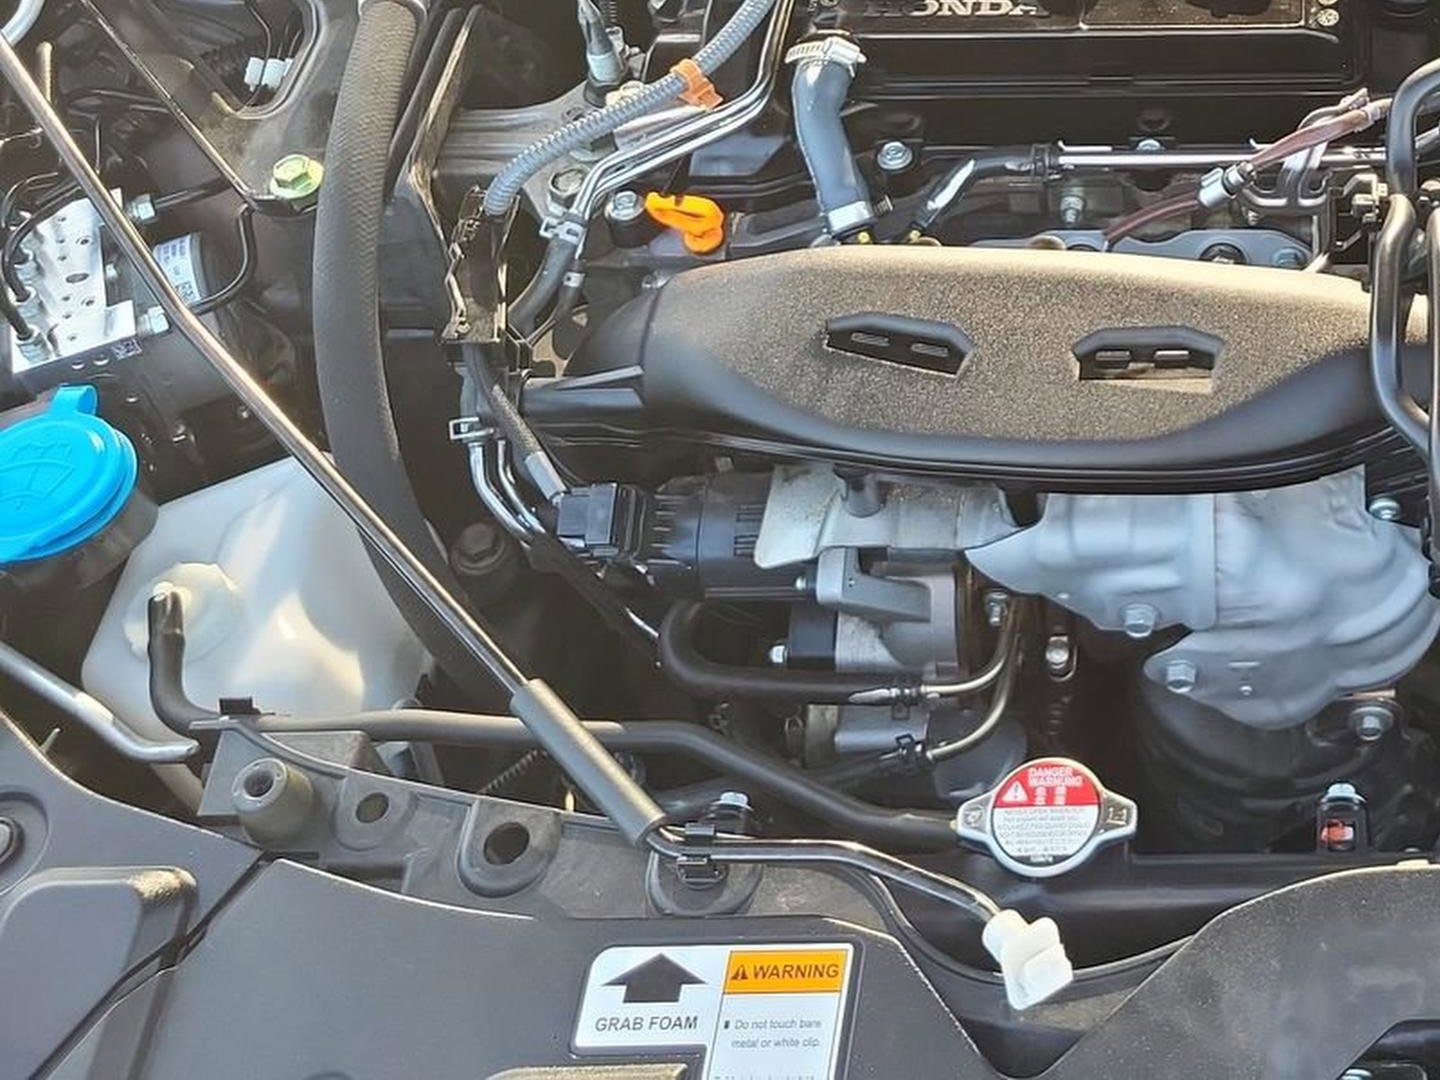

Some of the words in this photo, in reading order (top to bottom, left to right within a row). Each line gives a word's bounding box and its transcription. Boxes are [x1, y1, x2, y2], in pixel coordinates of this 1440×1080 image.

[1029, 767, 1072, 777] DANGER
[753, 963, 839, 979] WARNING
[594, 1016, 644, 1032] GRAB
[648, 1016, 698, 1031] FOAM
[735, 1019, 749, 1030] Do
[752, 1019, 768, 1029] not
[769, 1019, 798, 1029] touch
[731, 1037, 759, 1049] metal
[760, 1039, 772, 1048] or
